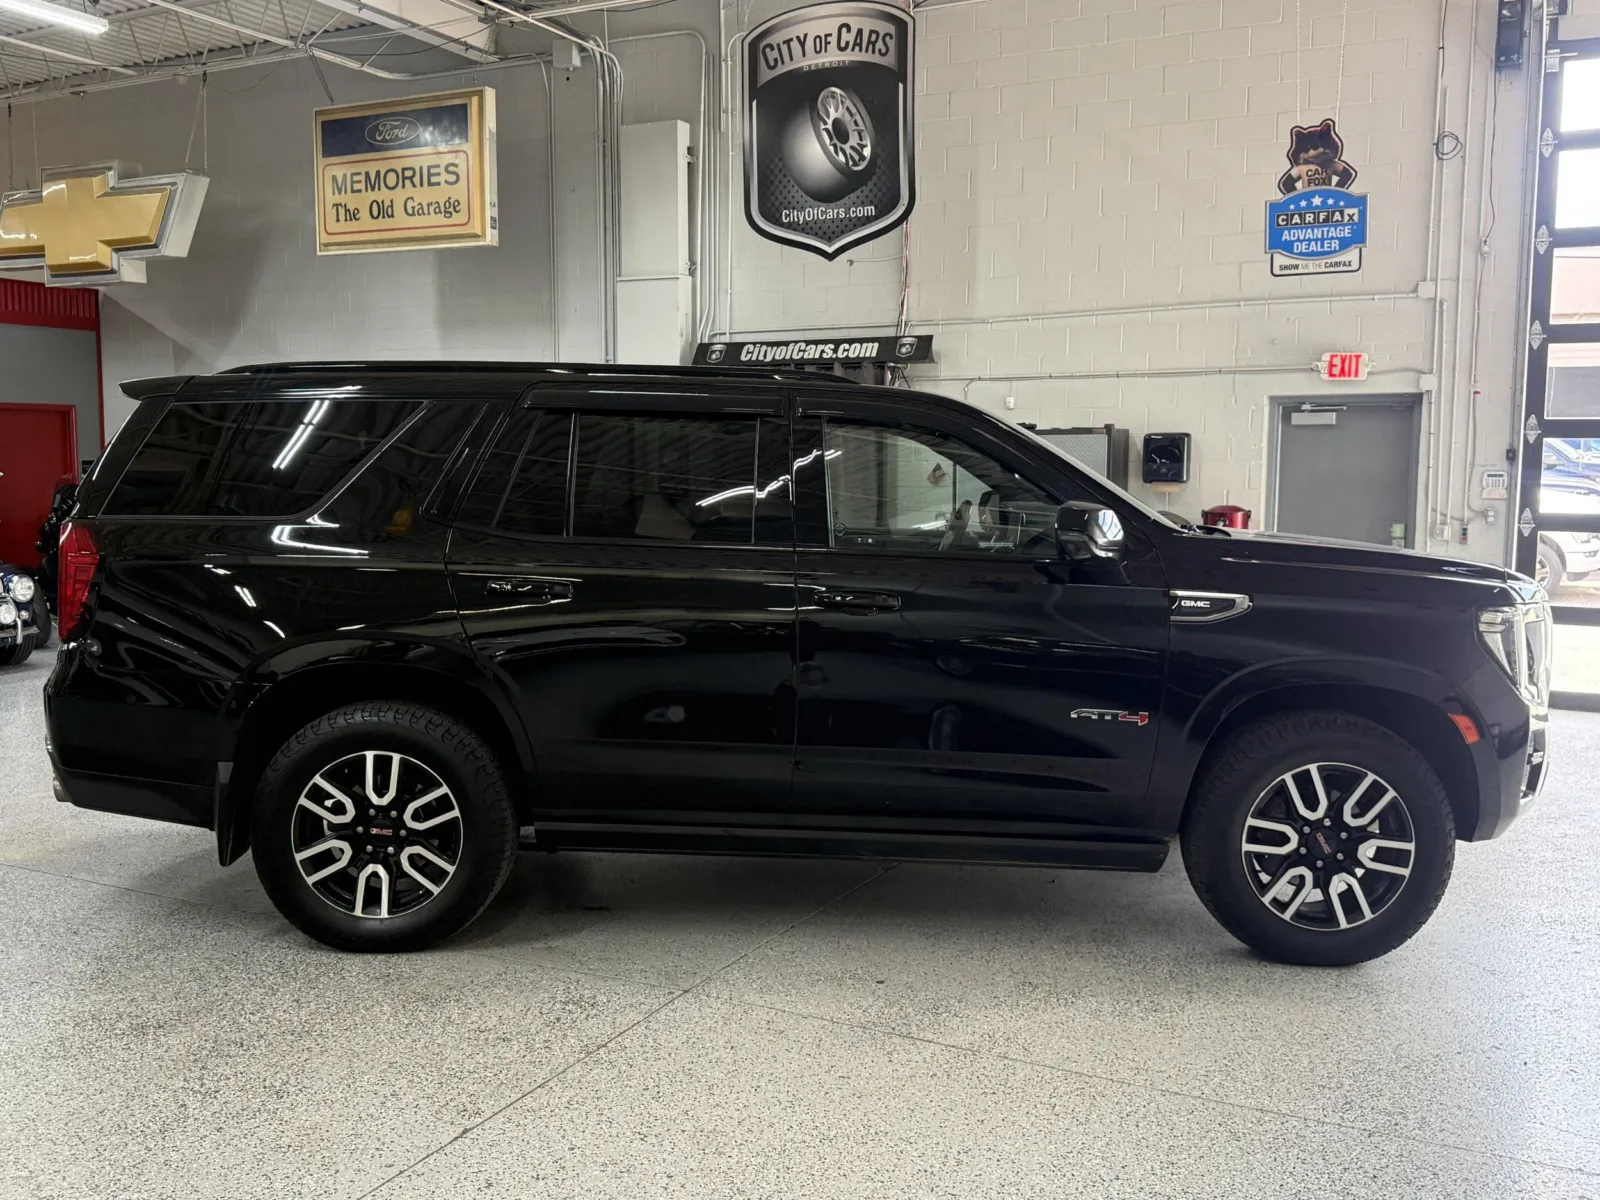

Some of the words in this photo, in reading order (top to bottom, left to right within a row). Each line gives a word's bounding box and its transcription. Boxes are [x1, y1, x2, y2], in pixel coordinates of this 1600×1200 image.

[761, 33, 808, 71] CITY
[813, 33, 833, 55] OF
[836, 22, 894, 57] CARS
[803, 60, 850, 71] DETROIT
[375, 120, 409, 141] Ford
[331, 162, 461, 197] MEMORIES
[1306, 167, 1328, 178] CAR
[1307, 177, 1327, 187] FOX
[332, 202, 361, 223] The
[369, 199, 395, 220] Old
[403, 196, 461, 219] Garage
[781, 205, 876, 225] CityOfCars.com
[1277, 210, 1358, 227] CARFAX
[1281, 226, 1352, 242] ADVANTAGE
[1293, 240, 1340, 254] DEALER
[1278, 263, 1300, 272] SHOW
[1323, 260, 1353, 269] CARFAX
[739, 341, 880, 363] CityofCars.com
[1328, 354, 1363, 378] EXIT
[1181, 600, 1211, 608] GMC
[1070, 708, 1149, 726] AT4
[369, 827, 393, 836] GMC
